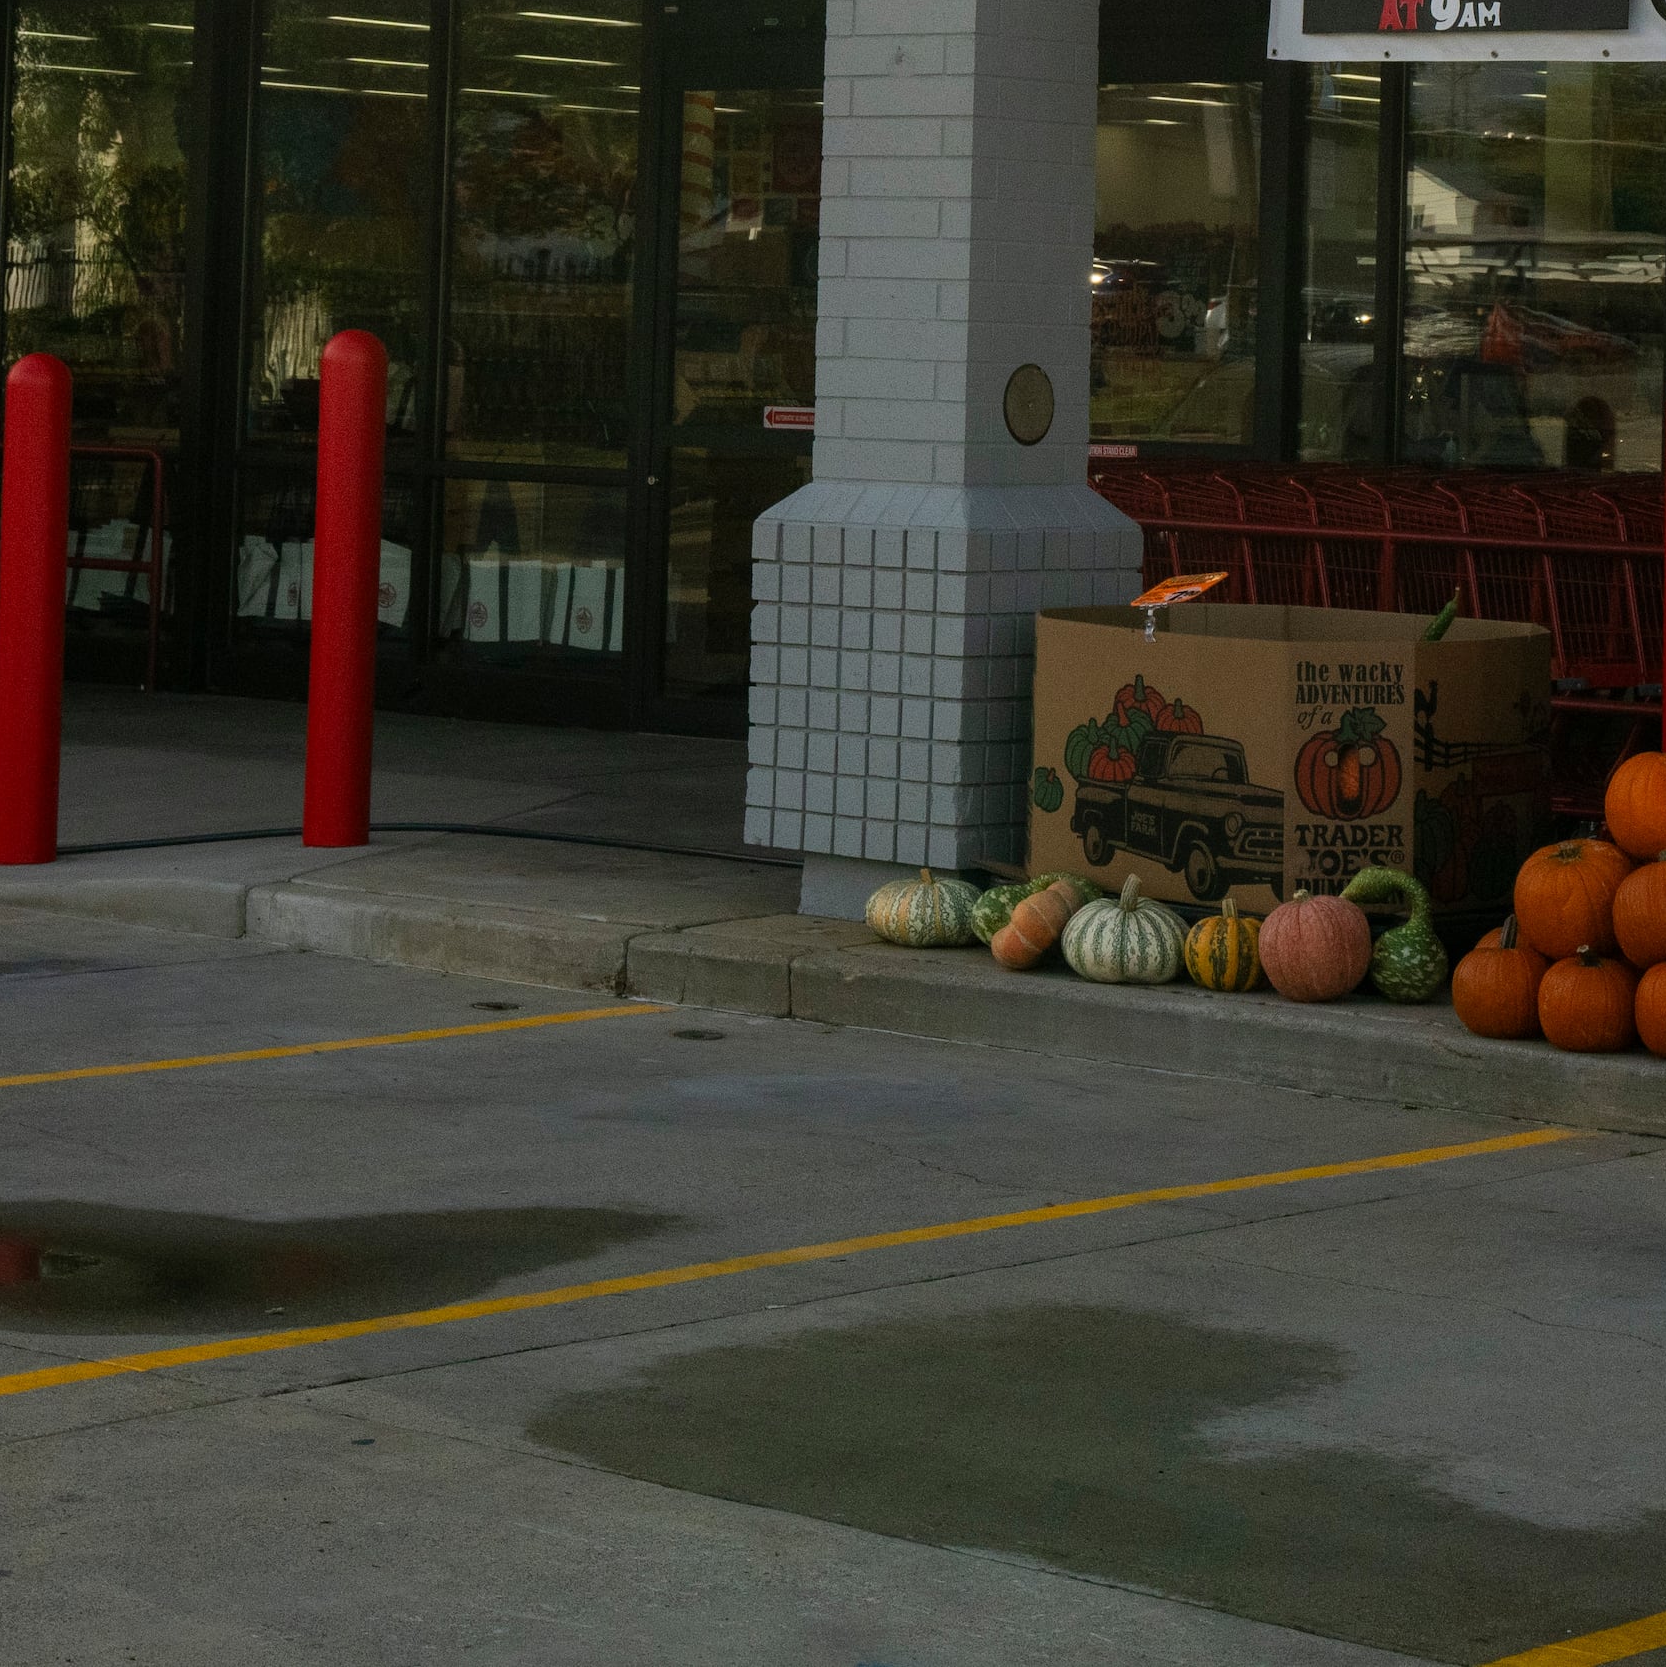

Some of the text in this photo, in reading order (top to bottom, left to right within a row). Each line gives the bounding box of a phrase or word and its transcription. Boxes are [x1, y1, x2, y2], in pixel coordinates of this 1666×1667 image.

[1296, 661, 1404, 686] the wacky
[1295, 684, 1405, 705] ADVENTURES
[1297, 705, 1334, 731] of a
[1294, 824, 1405, 847] TRADER
